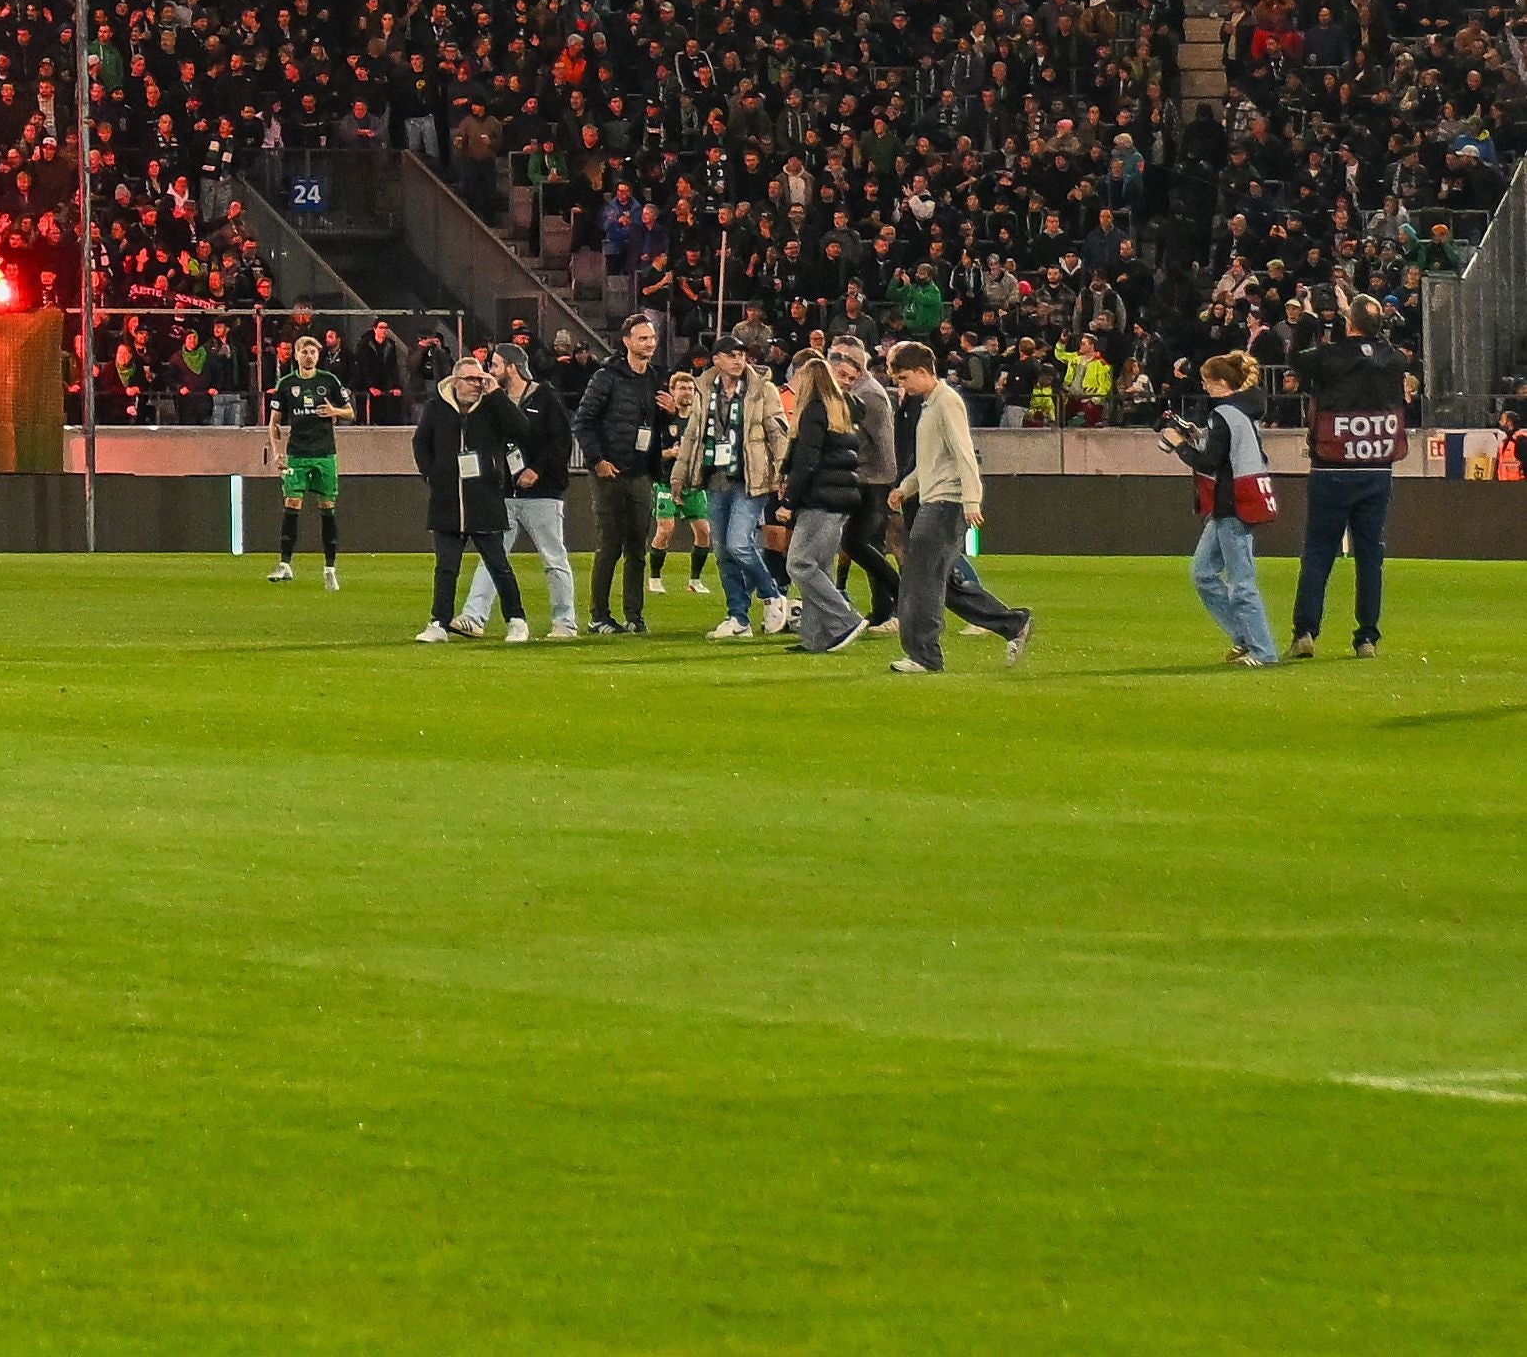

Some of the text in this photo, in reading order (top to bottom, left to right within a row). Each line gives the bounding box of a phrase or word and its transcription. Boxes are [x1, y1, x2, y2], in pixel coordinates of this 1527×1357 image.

[293, 184, 322, 204] 24
[1334, 414, 1399, 437] FOTO
[1344, 438, 1395, 460] 1017
